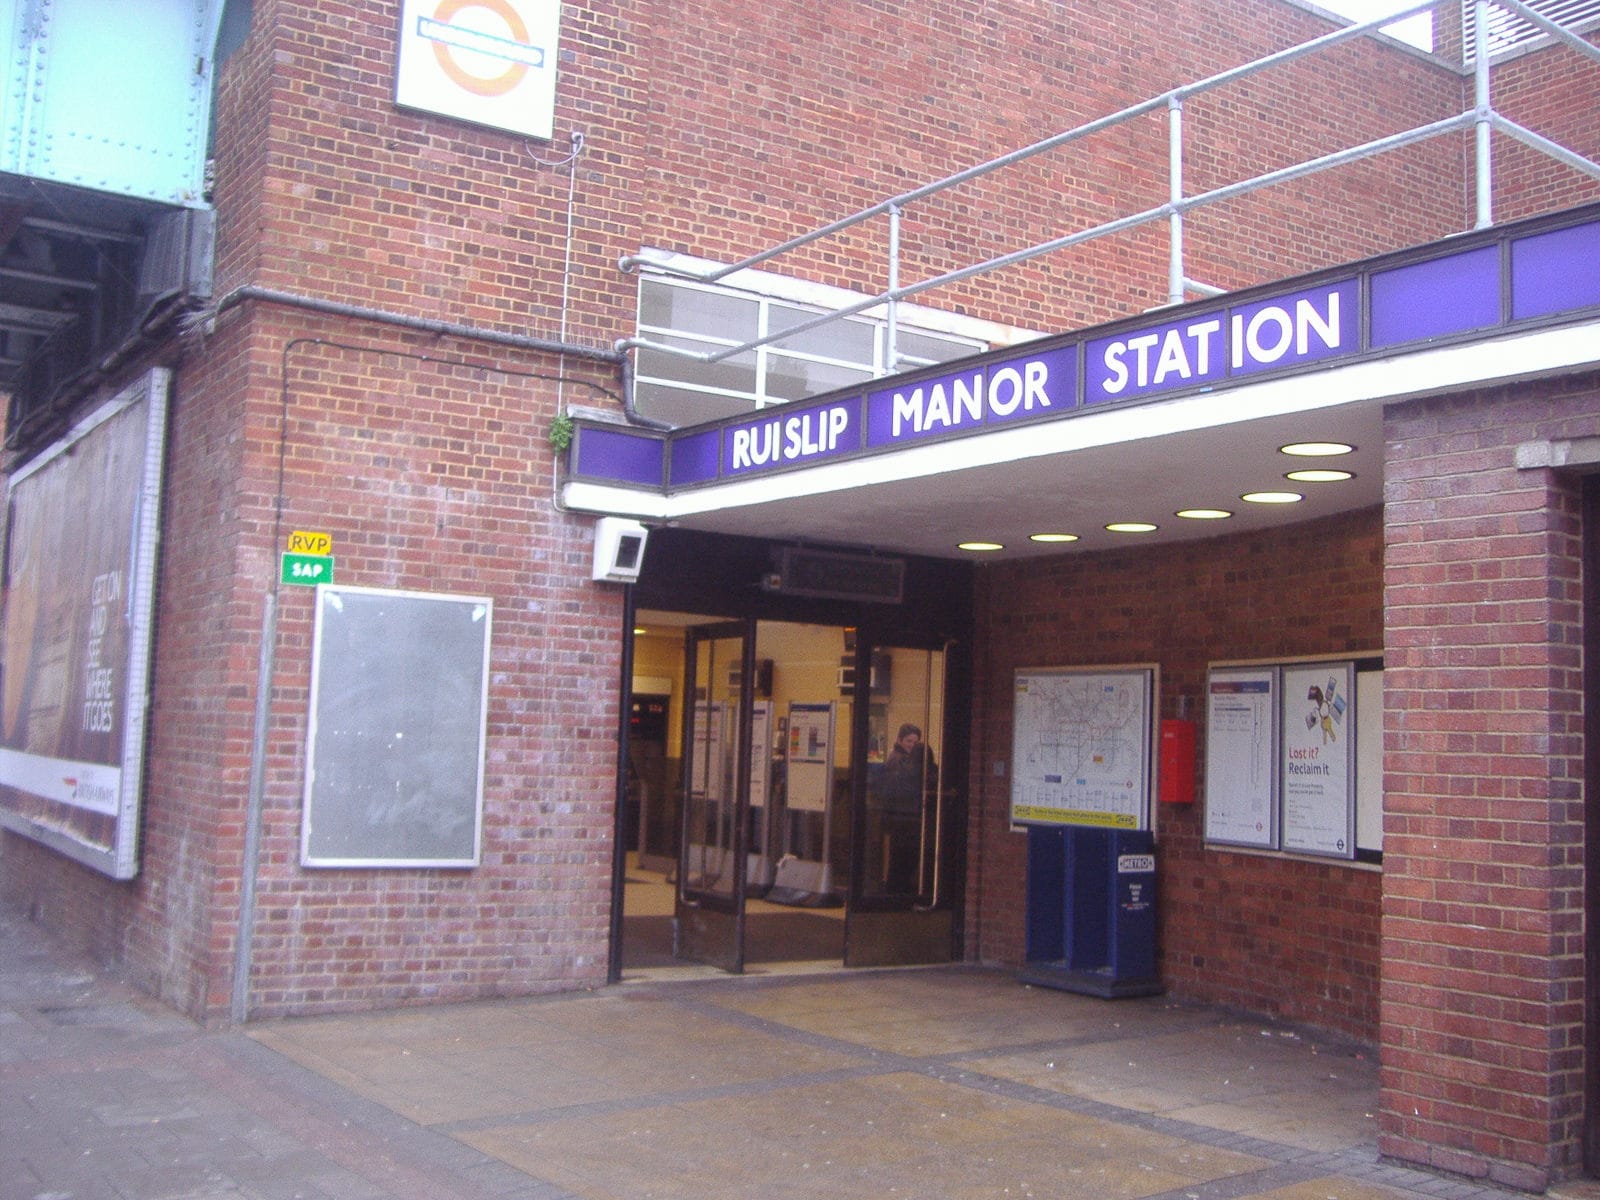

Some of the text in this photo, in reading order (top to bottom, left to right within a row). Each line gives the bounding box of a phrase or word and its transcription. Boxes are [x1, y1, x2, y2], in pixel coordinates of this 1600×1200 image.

[732, 292, 1340, 469] RUISLIP MANOR STATION
[292, 535, 328, 551] RVP
[292, 562, 323, 577] SAP
[1289, 746, 1319, 759] Lost it?
[1289, 762, 1329, 776] Reclaim it
[1123, 858, 1149, 869] METRO
